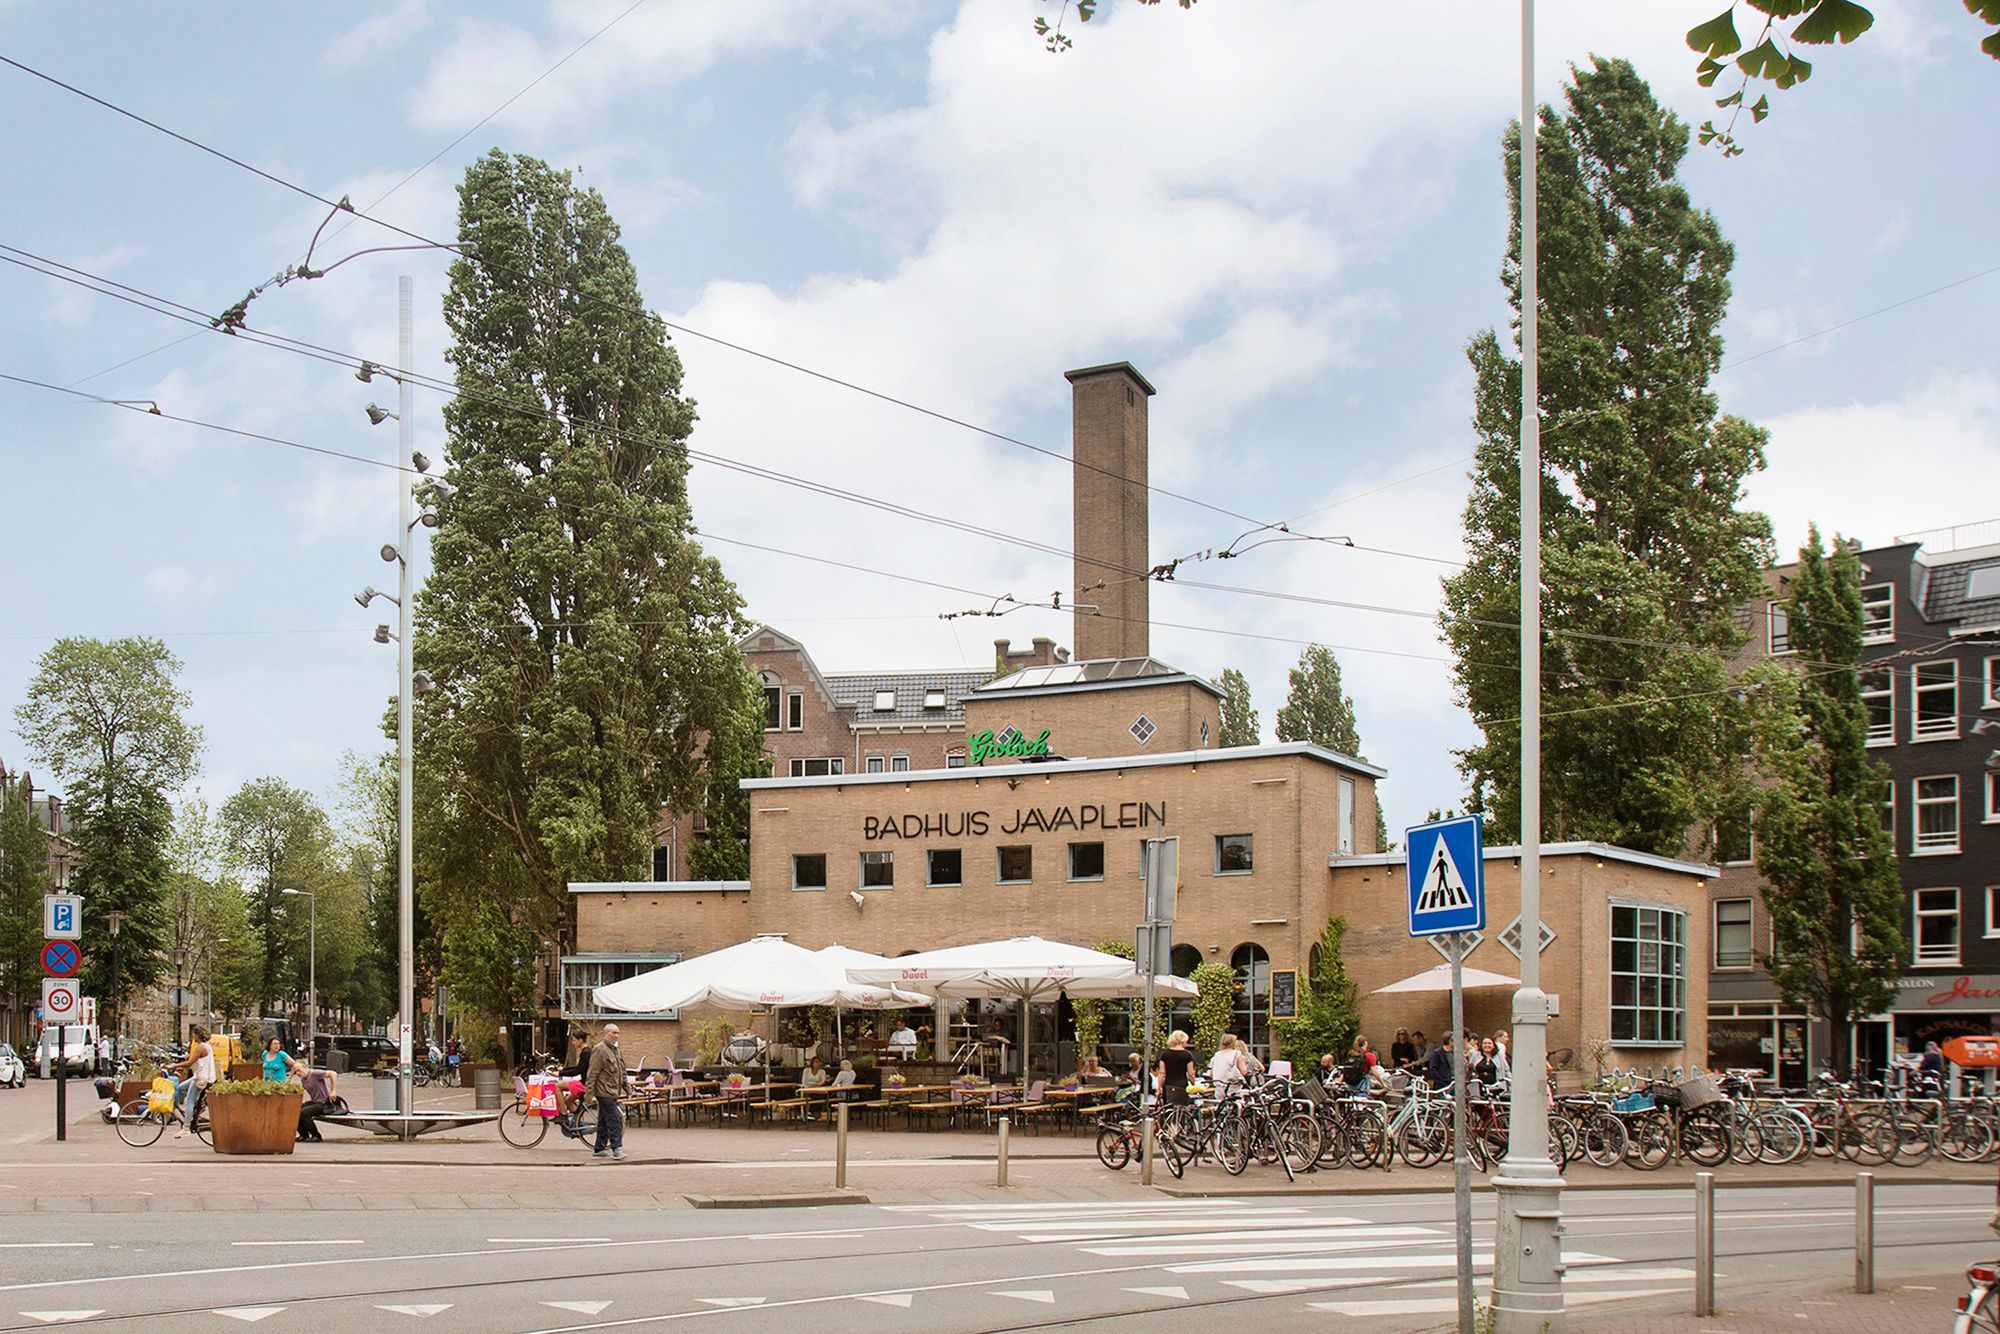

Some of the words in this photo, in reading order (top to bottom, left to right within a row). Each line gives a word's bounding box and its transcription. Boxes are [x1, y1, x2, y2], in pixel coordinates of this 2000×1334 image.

[968, 728, 1050, 763] Grolsch
[864, 811, 990, 840] BADHUIS
[1001, 800, 1166, 834] JAVAPLEIN
[58, 906, 69, 920] P
[902, 969, 928, 980] Duvel
[1047, 967, 1074, 976] Duvel
[53, 996, 68, 1005] 30
